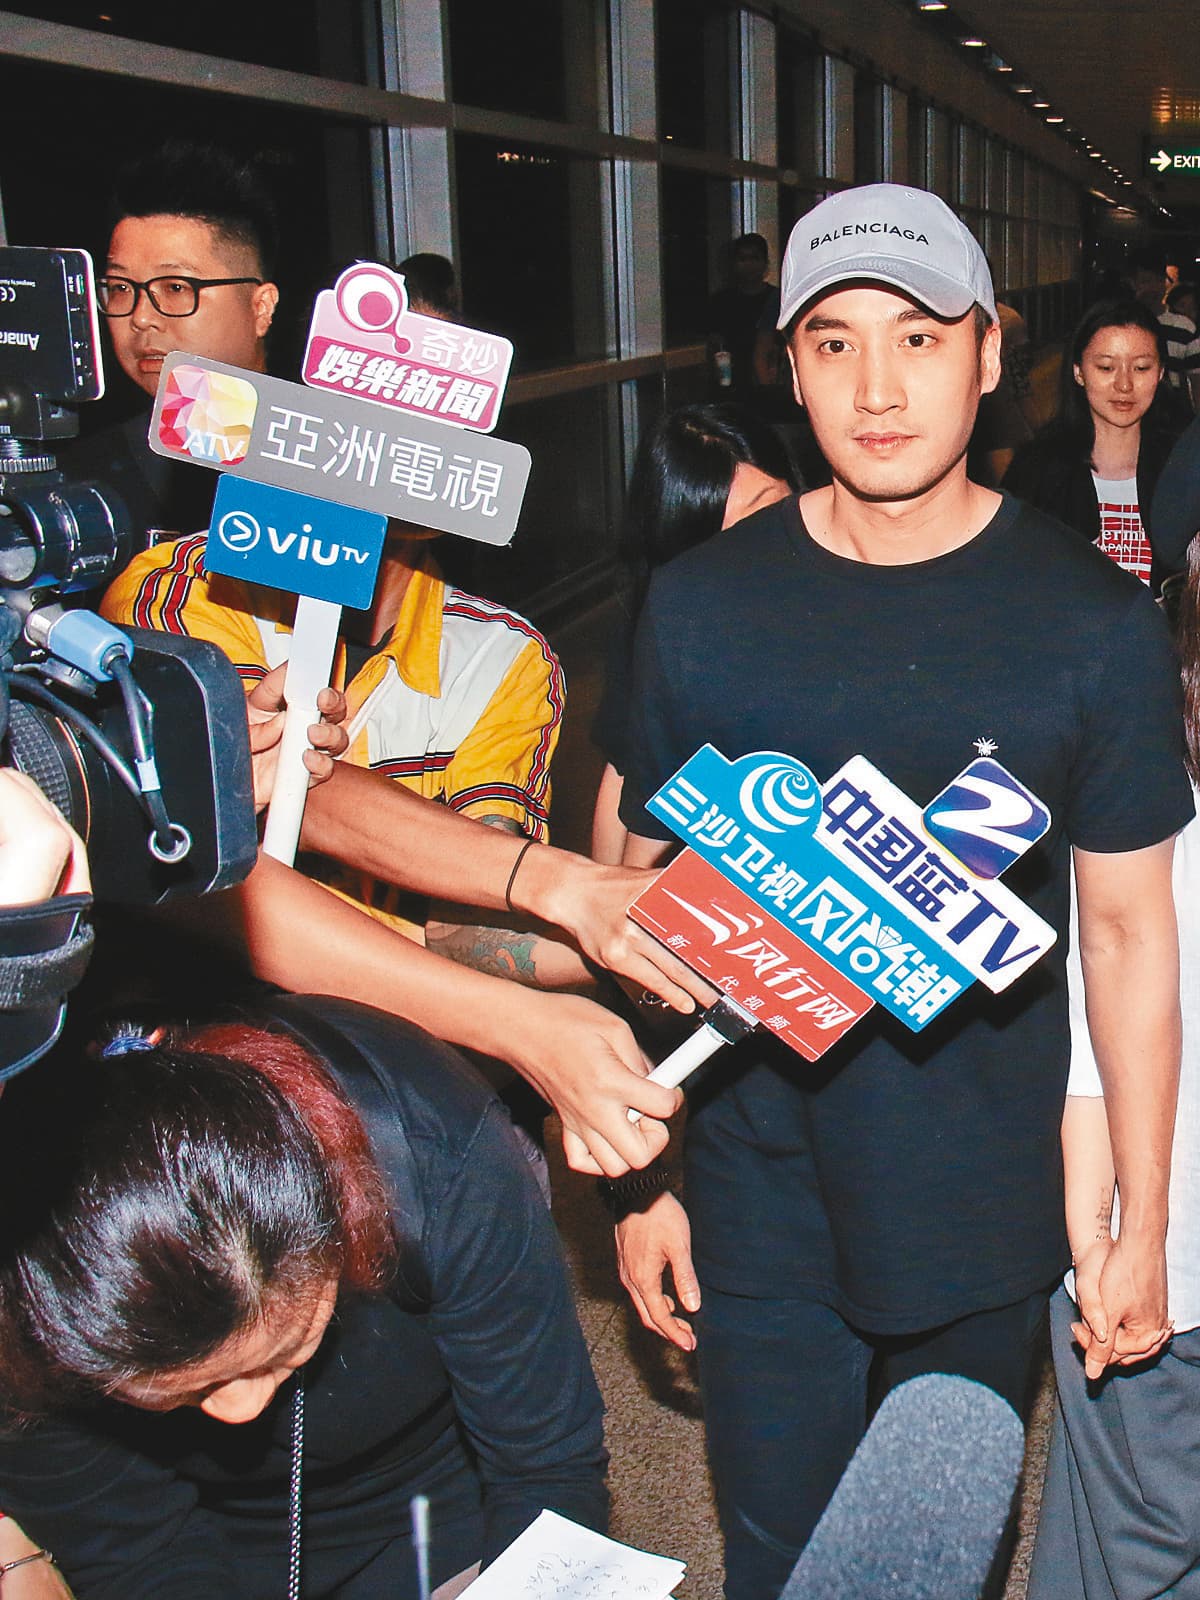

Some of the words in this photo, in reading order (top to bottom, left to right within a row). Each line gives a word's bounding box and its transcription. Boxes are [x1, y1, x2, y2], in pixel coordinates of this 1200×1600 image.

[810, 223, 929, 250] BALENCIAGA
[421, 327, 498, 376] 奇妙
[182, 431, 245, 461] ATV
[260, 405, 504, 518] 亞洲電視
[655, 776, 809, 910] 三沙卫视
[725, 938, 857, 1030] 风行网
